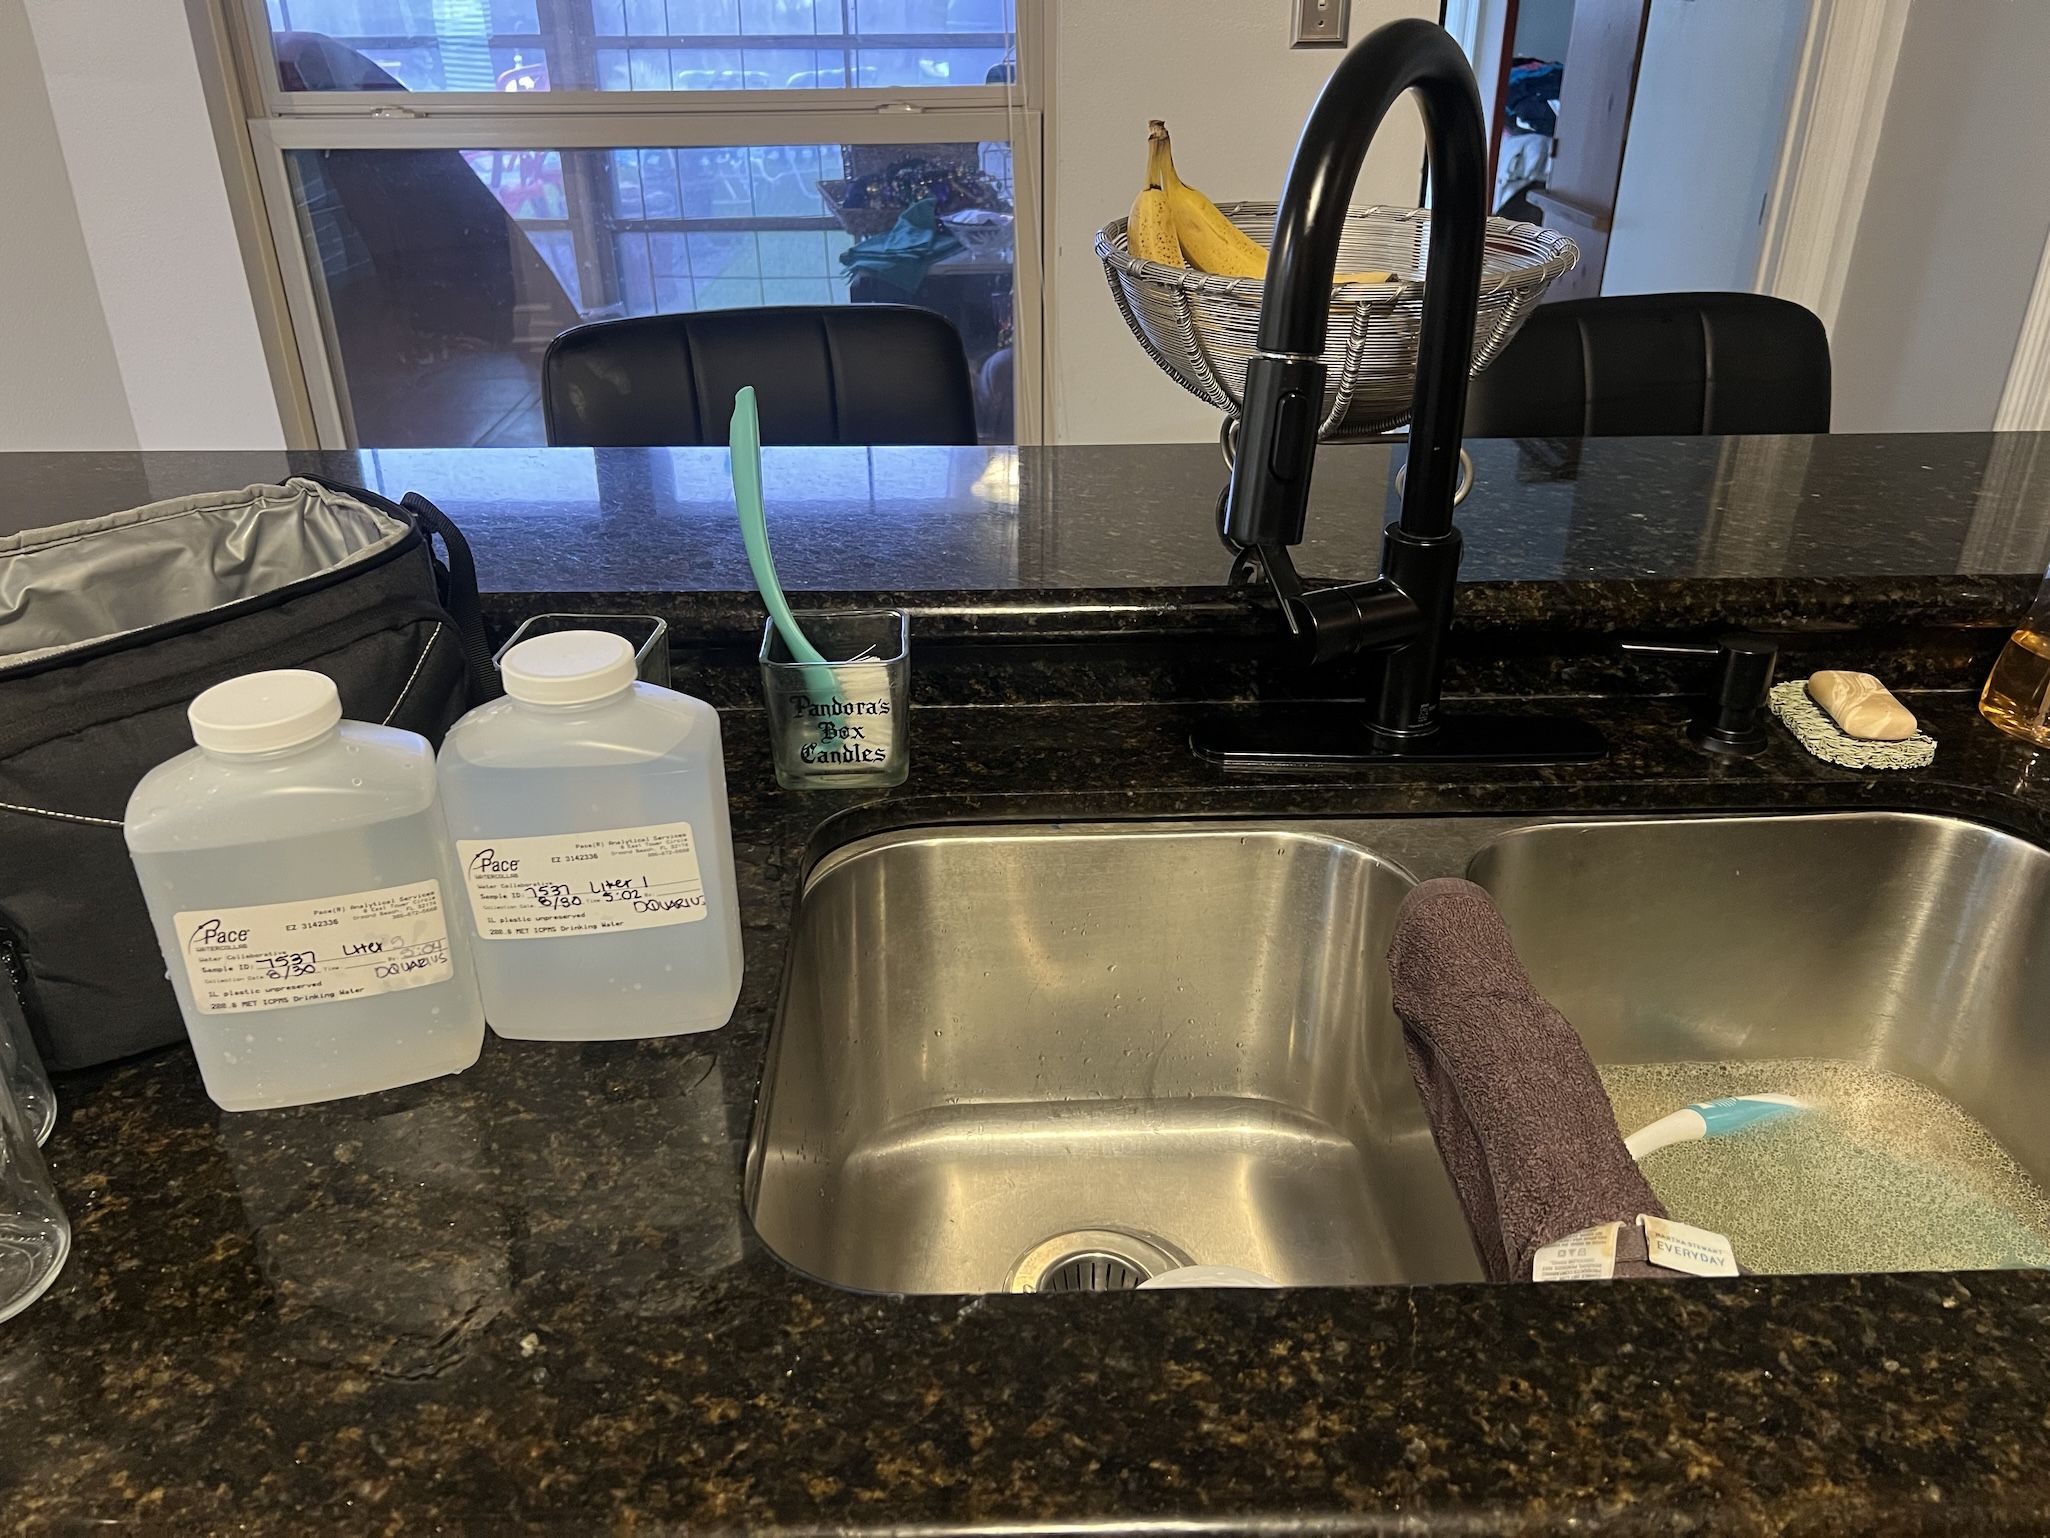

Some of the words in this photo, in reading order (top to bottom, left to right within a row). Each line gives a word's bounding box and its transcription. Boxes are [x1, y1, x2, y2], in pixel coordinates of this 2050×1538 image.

[789, 695, 891, 719] Pandora's
[817, 721, 866, 744] Box
[800, 742, 887, 765] Candles
[608, 837, 650, 848] Analytical
[653, 833, 687, 842] Services
[470, 849, 520, 874] Pace
[565, 853, 599, 863] 3142336
[349, 898, 395, 910] Analytical
[399, 891, 435, 902] Services
[524, 884, 570, 899] 7537
[285, 924, 297, 932] EZ
[301, 918, 339, 930] 3142336
[500, 915, 532, 924] plastic
[535, 912, 586, 922] unpreserved
[560, 923, 598, 932] Drinking
[600, 921, 625, 929] Water
[189, 919, 250, 947] Pace
[256, 950, 316, 969] 7537
[201, 966, 234, 974] Sample
[223, 988, 261, 998] plastic
[265, 980, 323, 993] unpreserved
[241, 1000, 257, 1008] MET
[293, 992, 335, 1002] Drinking
[339, 987, 365, 996] Water
[1656, 1240, 1725, 1267] EVERYDAY
